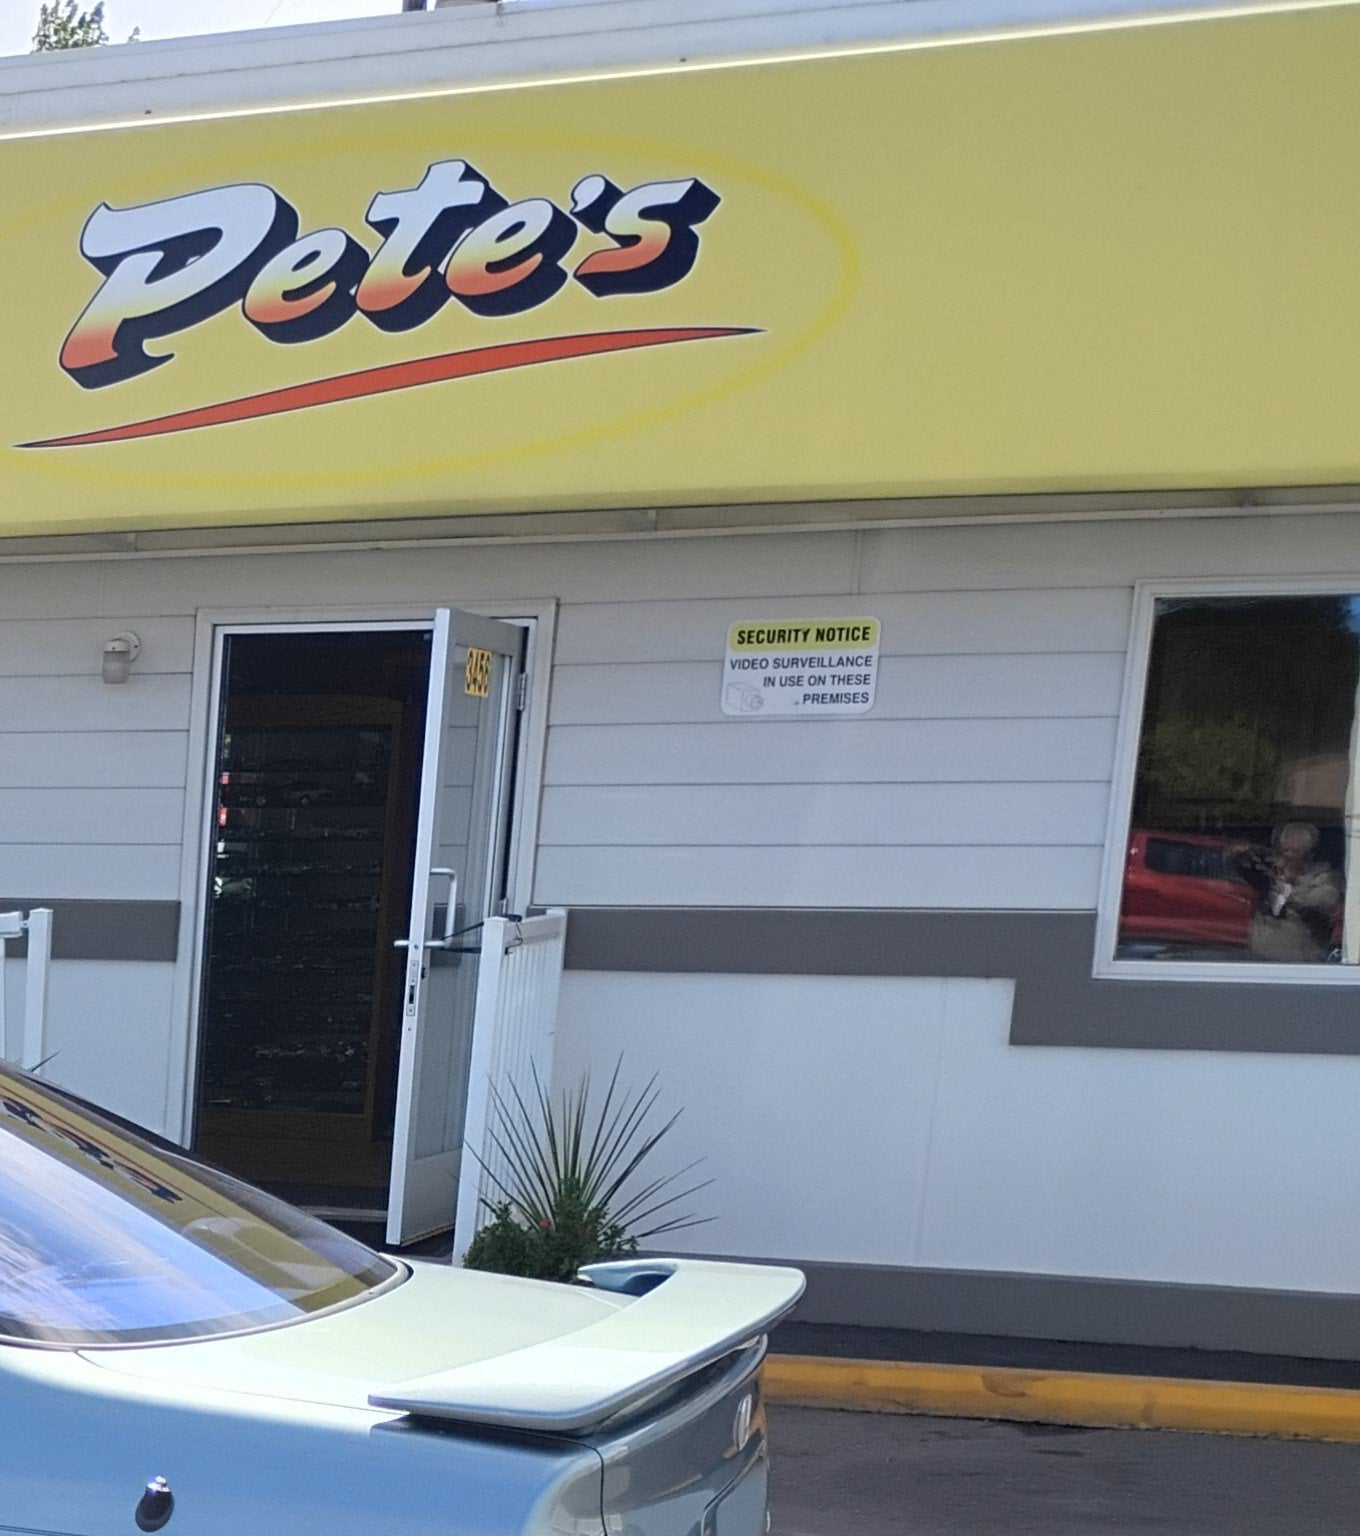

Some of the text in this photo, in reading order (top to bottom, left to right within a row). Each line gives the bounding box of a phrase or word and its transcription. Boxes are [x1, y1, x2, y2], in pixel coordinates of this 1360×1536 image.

[60, 160, 721, 389] Pete's
[737, 626, 871, 645] SECURITY NOTICE
[730, 655, 873, 670] VIDEO SURVEILLANCE
[763, 673, 872, 688] IN USE ON THESE
[802, 692, 869, 705] PREMISES
